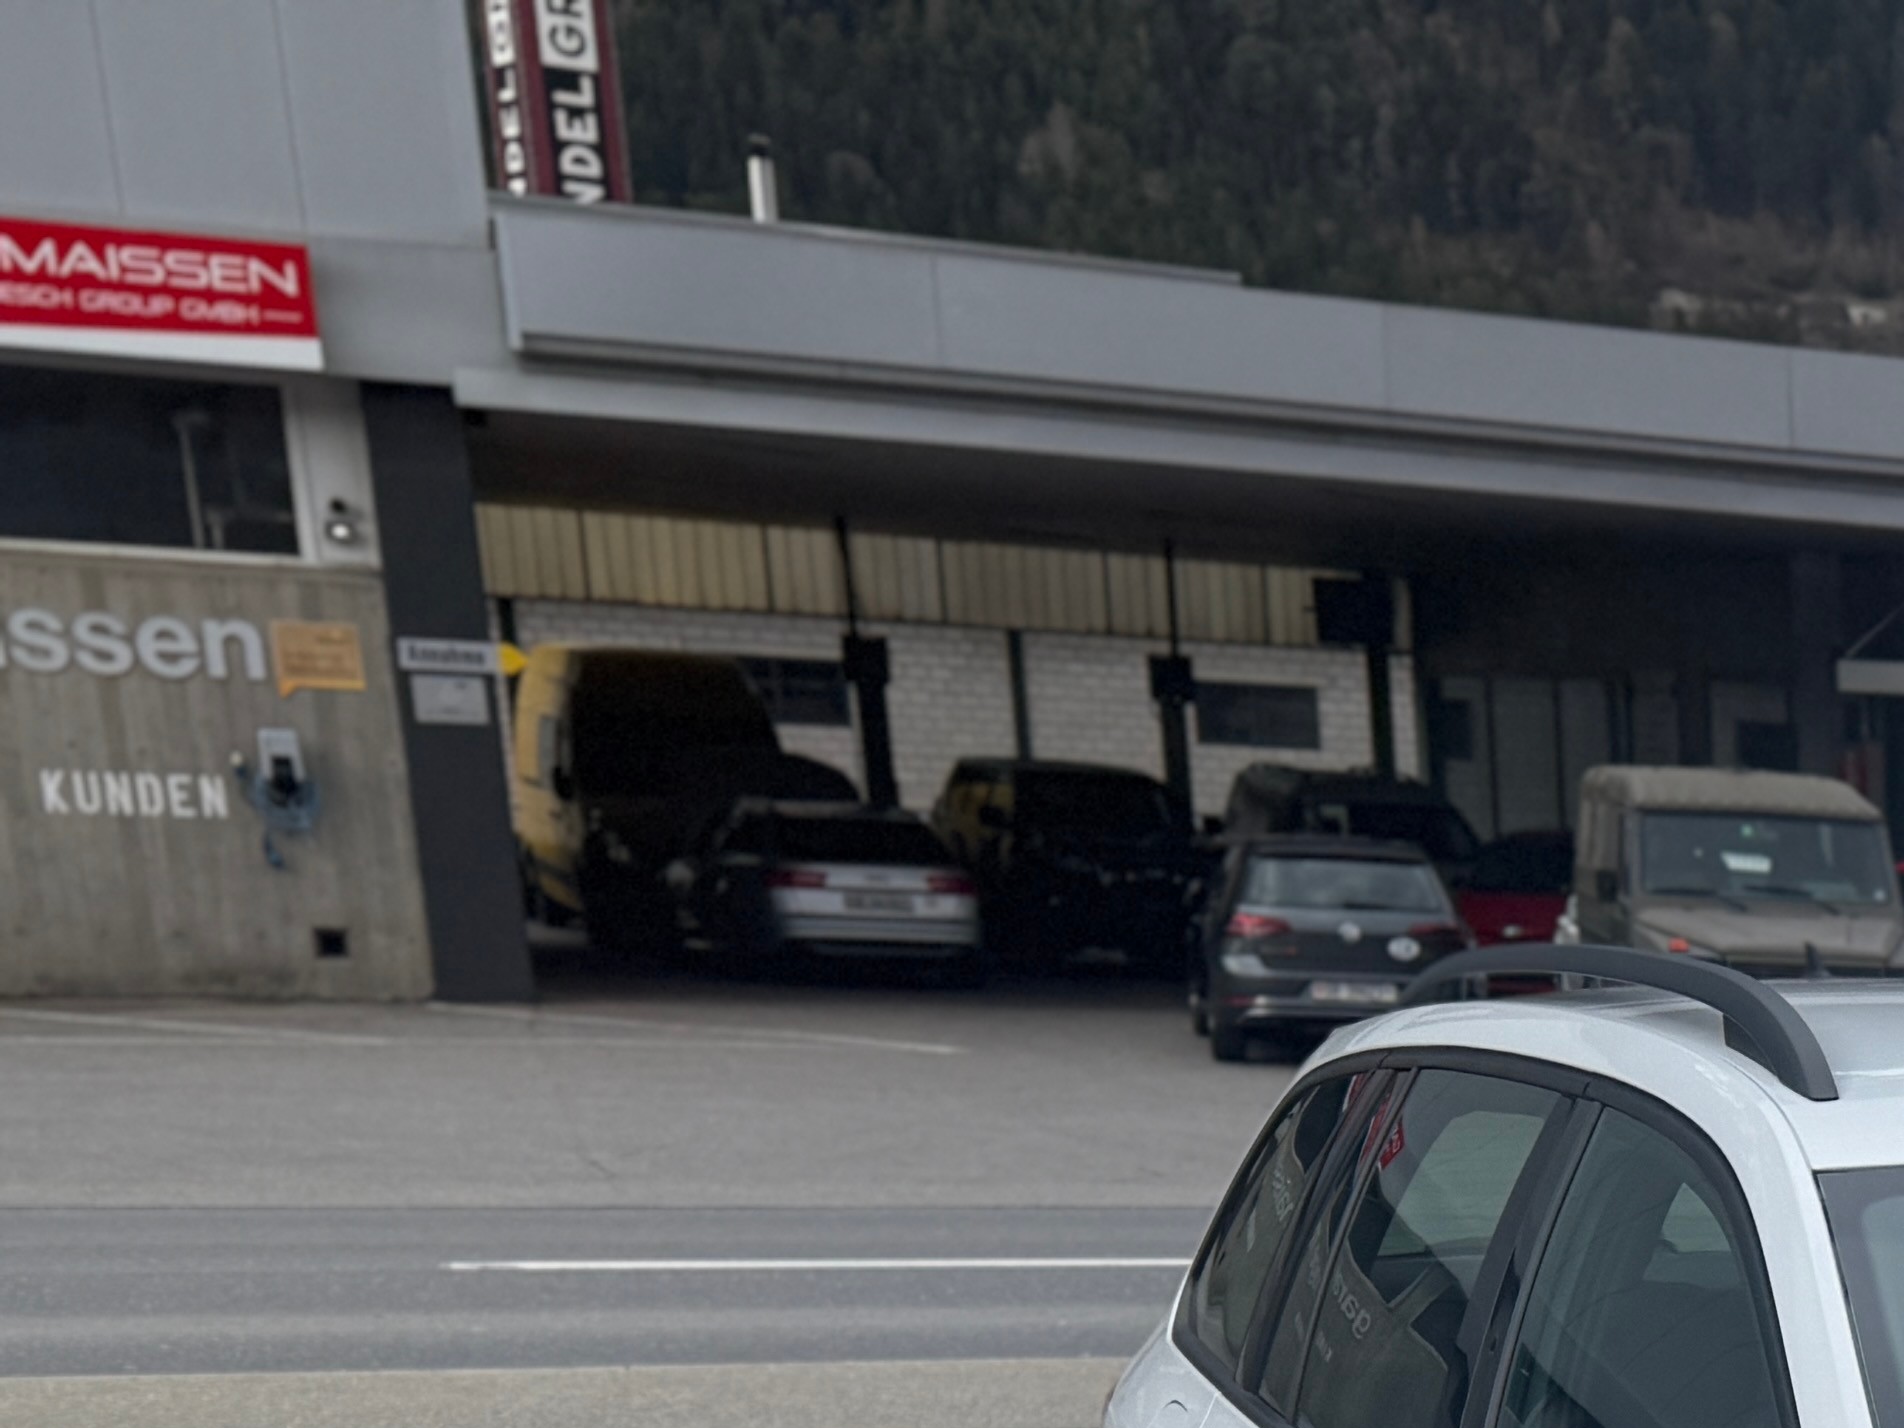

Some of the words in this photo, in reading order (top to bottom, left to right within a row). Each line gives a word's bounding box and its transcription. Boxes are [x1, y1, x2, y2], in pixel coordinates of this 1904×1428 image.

[0, 233, 299, 298] MAISSEN
[0, 608, 266, 681] ssen
[39, 767, 228, 819] KUNDEN
